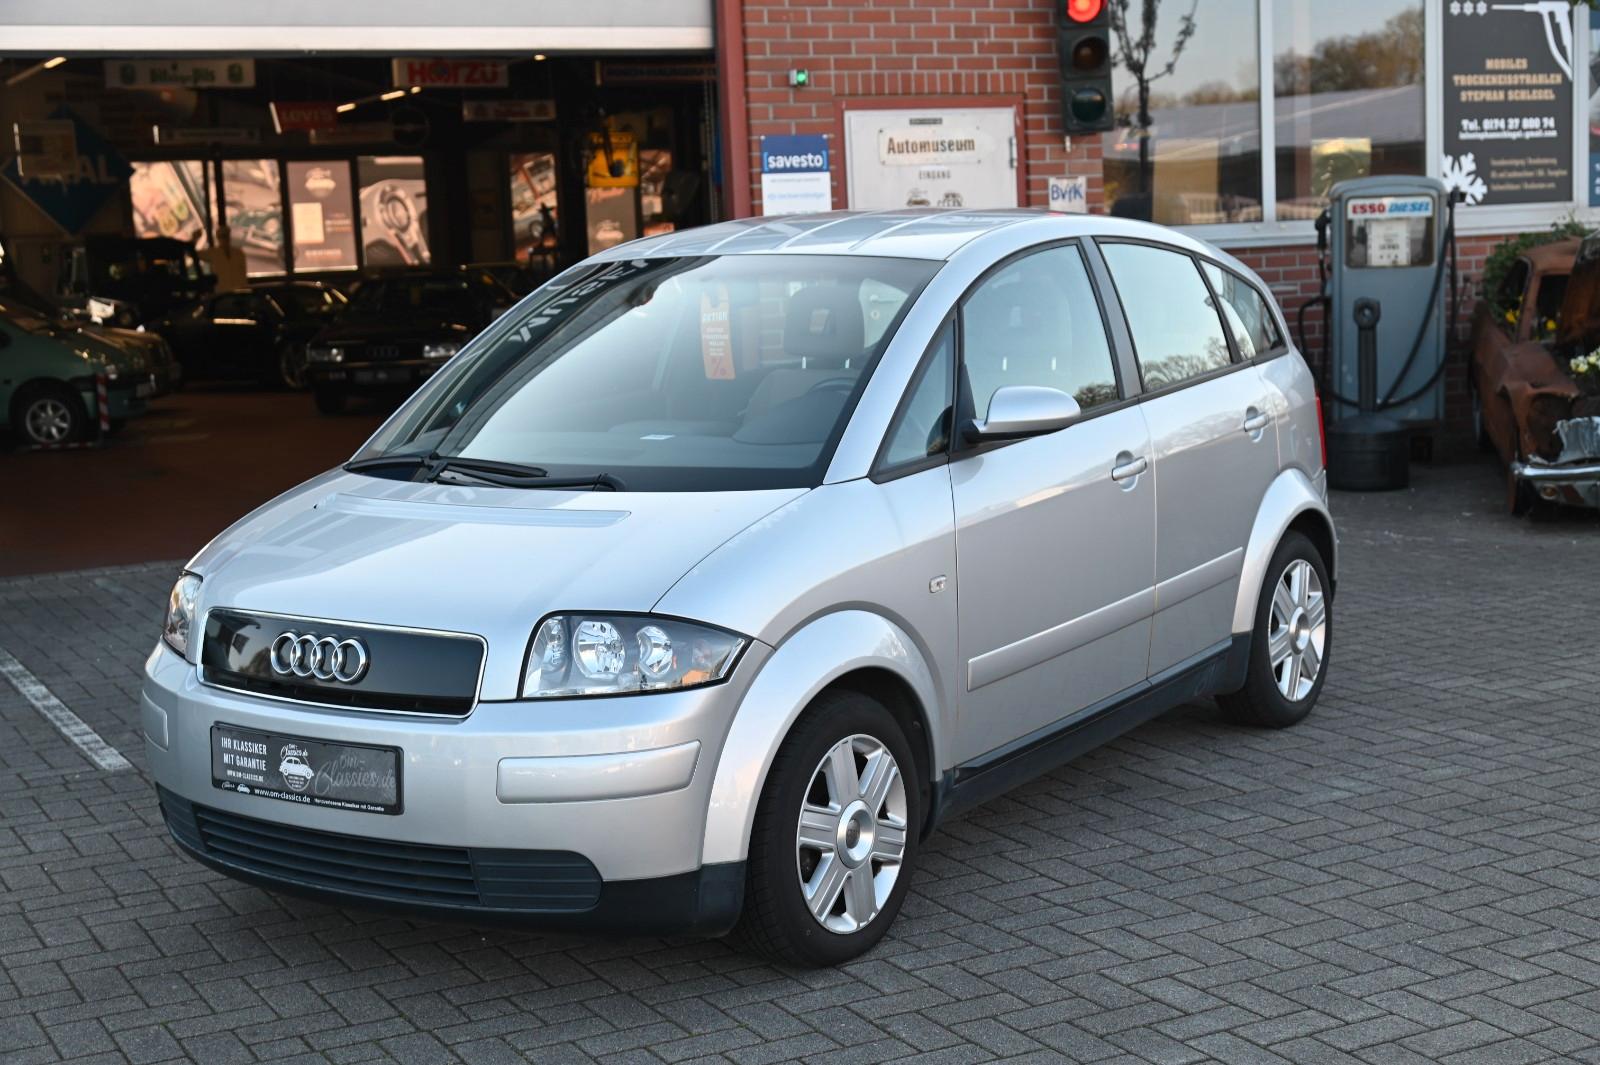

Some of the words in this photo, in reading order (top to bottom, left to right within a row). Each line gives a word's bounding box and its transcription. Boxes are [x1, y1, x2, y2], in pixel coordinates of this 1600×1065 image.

[887, 137, 975, 154] Automuseum
[1352, 203, 1386, 215] ESSO
[1388, 202, 1430, 213] DIESEL
[221, 736, 232, 749] IHR
[233, 739, 267, 755] KLASSIKER
[223, 752, 234, 765] MIT
[236, 755, 267, 771] GARANTIE
[254, 788, 311, 803] www.om-classics.de
